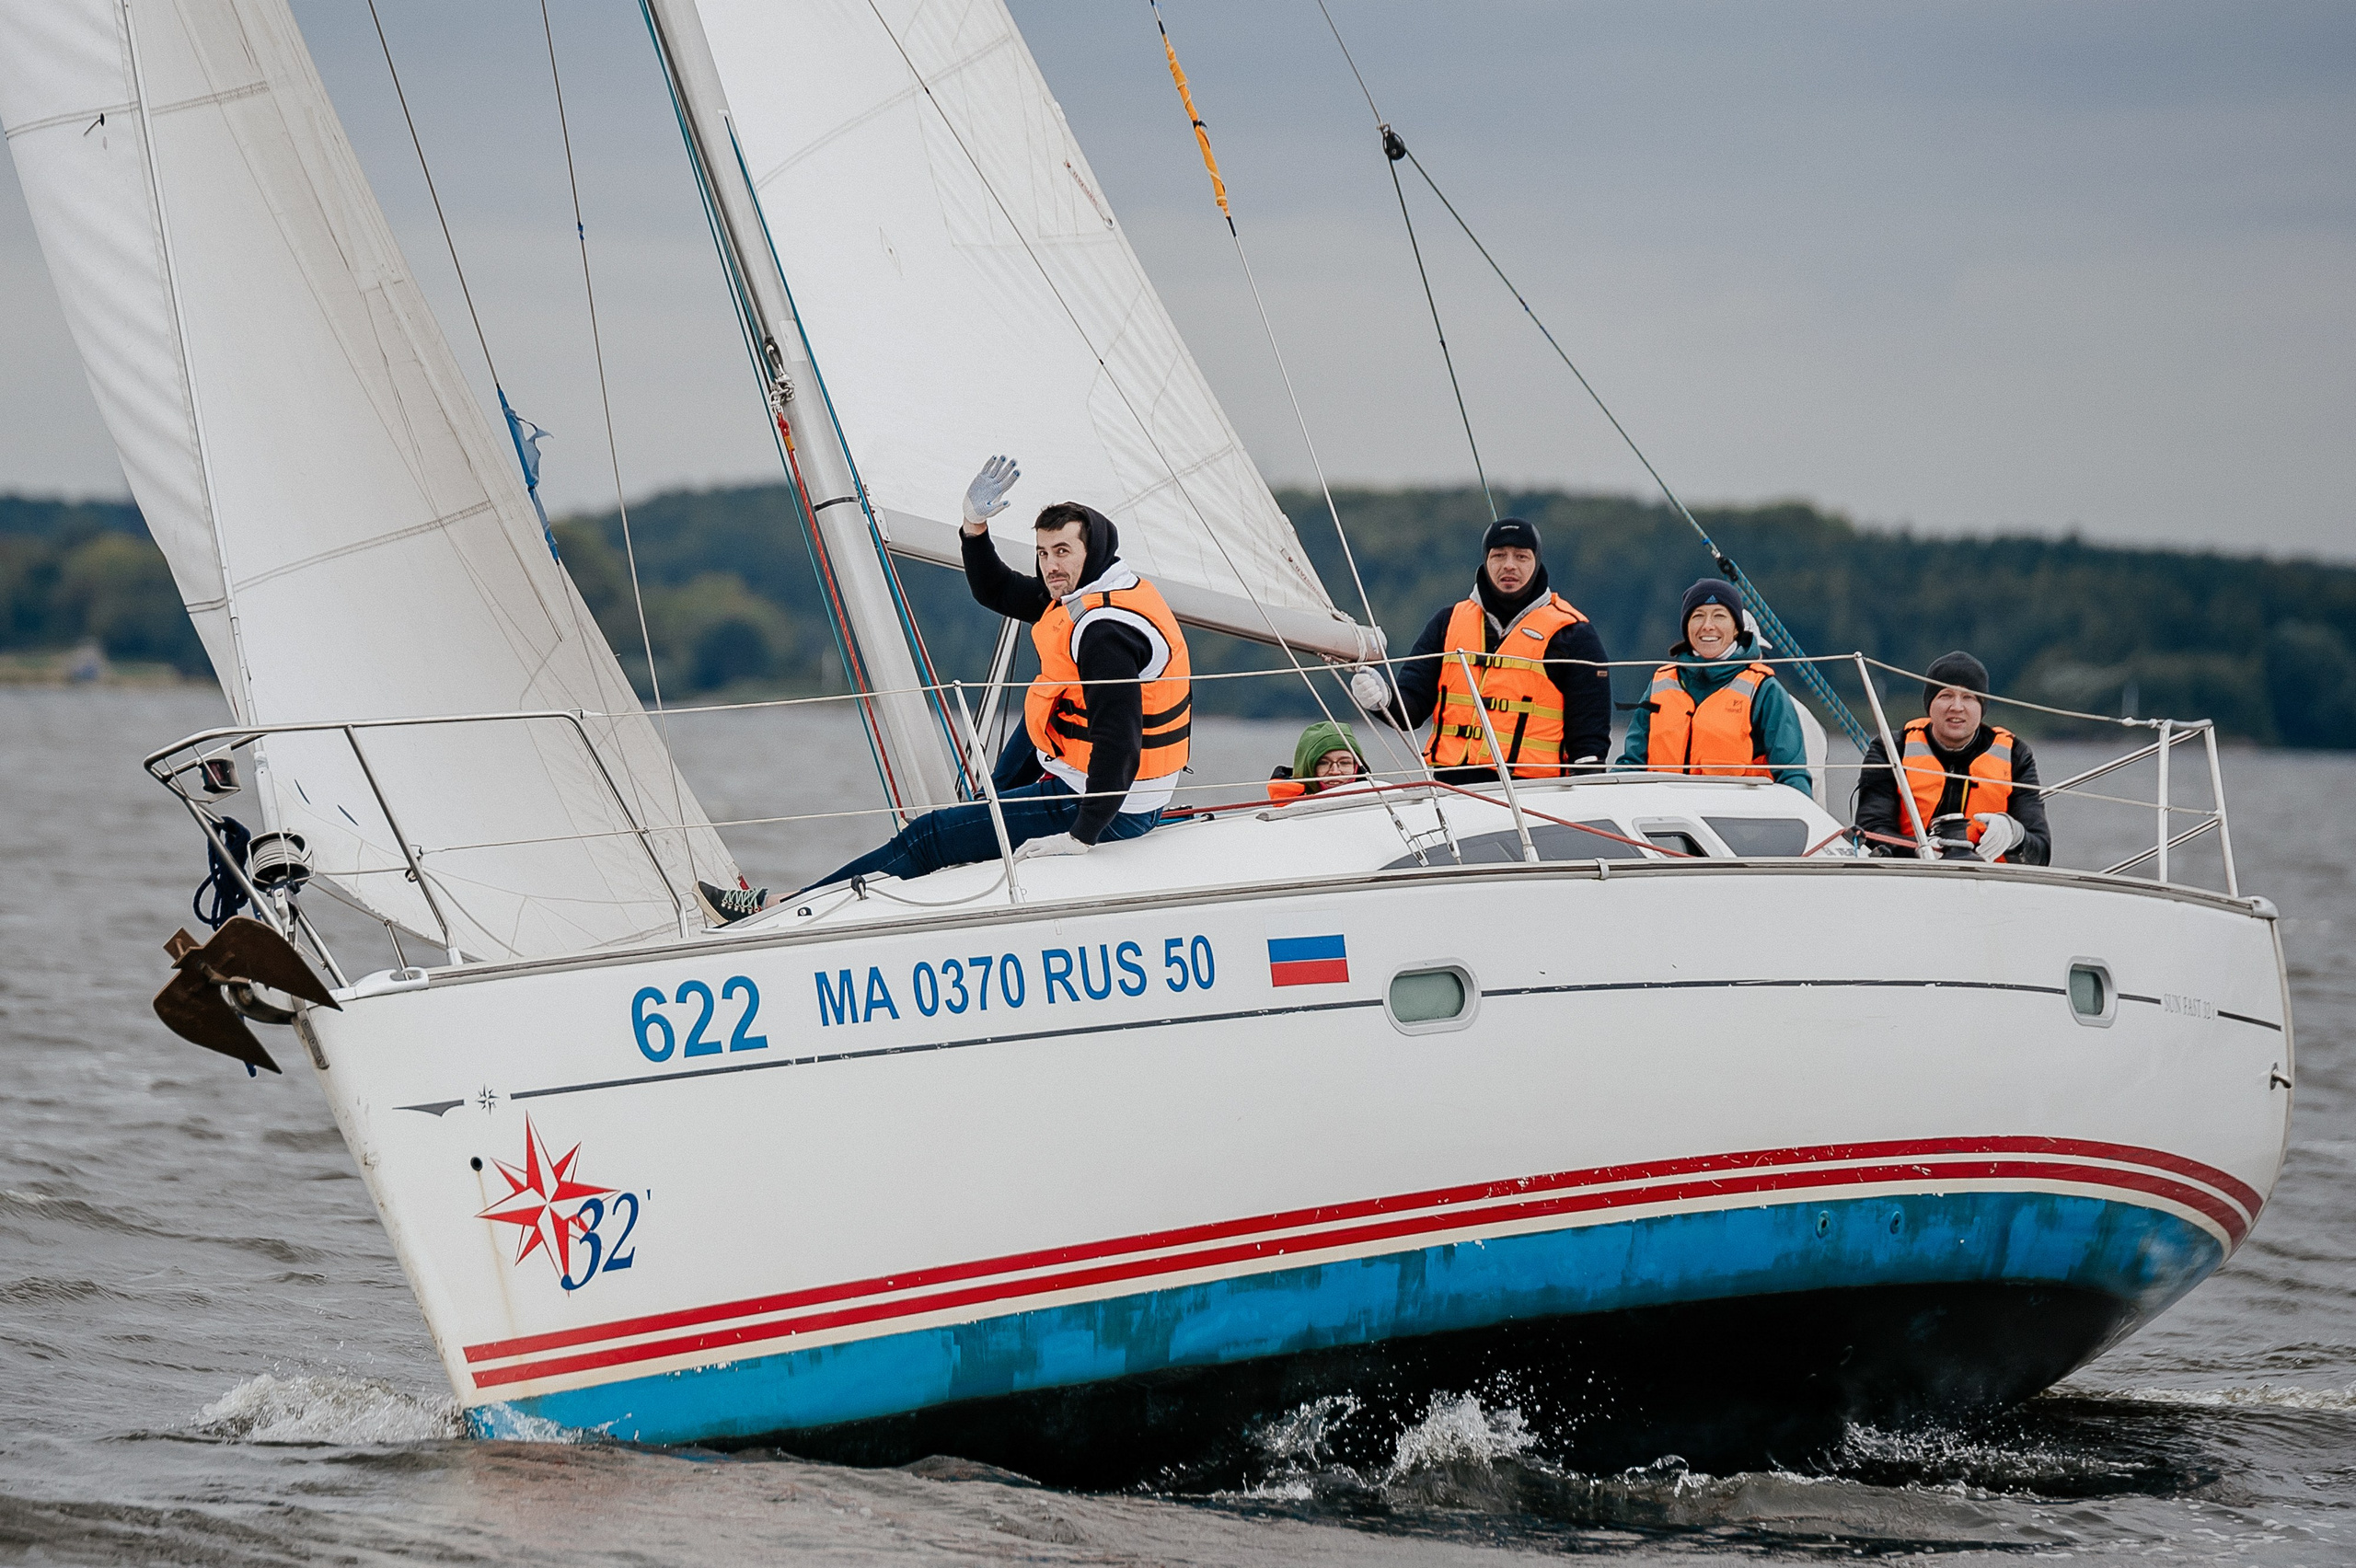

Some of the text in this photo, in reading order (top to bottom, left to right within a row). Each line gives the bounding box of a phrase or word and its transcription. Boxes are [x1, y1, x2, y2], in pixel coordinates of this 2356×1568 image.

[632, 976, 768, 1062] 622
[815, 936, 1214, 1026] MA 0370 RUS 50
